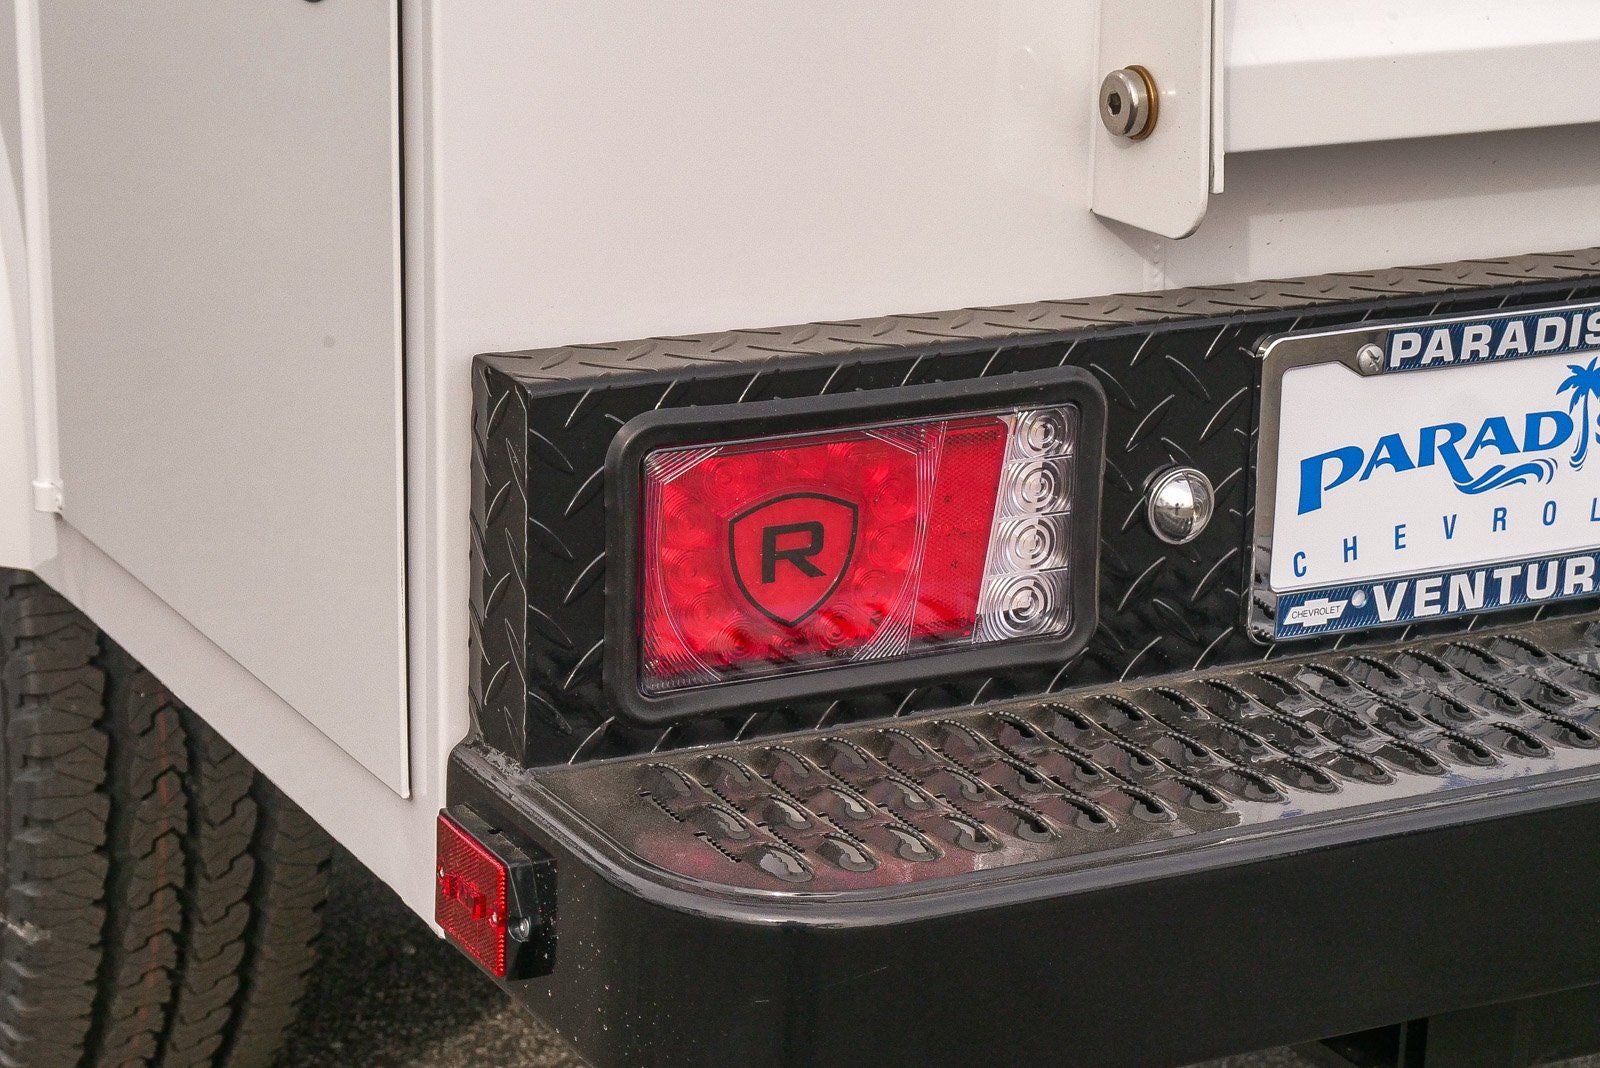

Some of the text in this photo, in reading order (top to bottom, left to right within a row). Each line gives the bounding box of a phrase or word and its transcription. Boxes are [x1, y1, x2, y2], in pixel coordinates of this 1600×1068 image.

[763, 521, 826, 583] R
[1291, 605, 1341, 619] CHEVROLET
[1374, 556, 1595, 622] VENTUR
